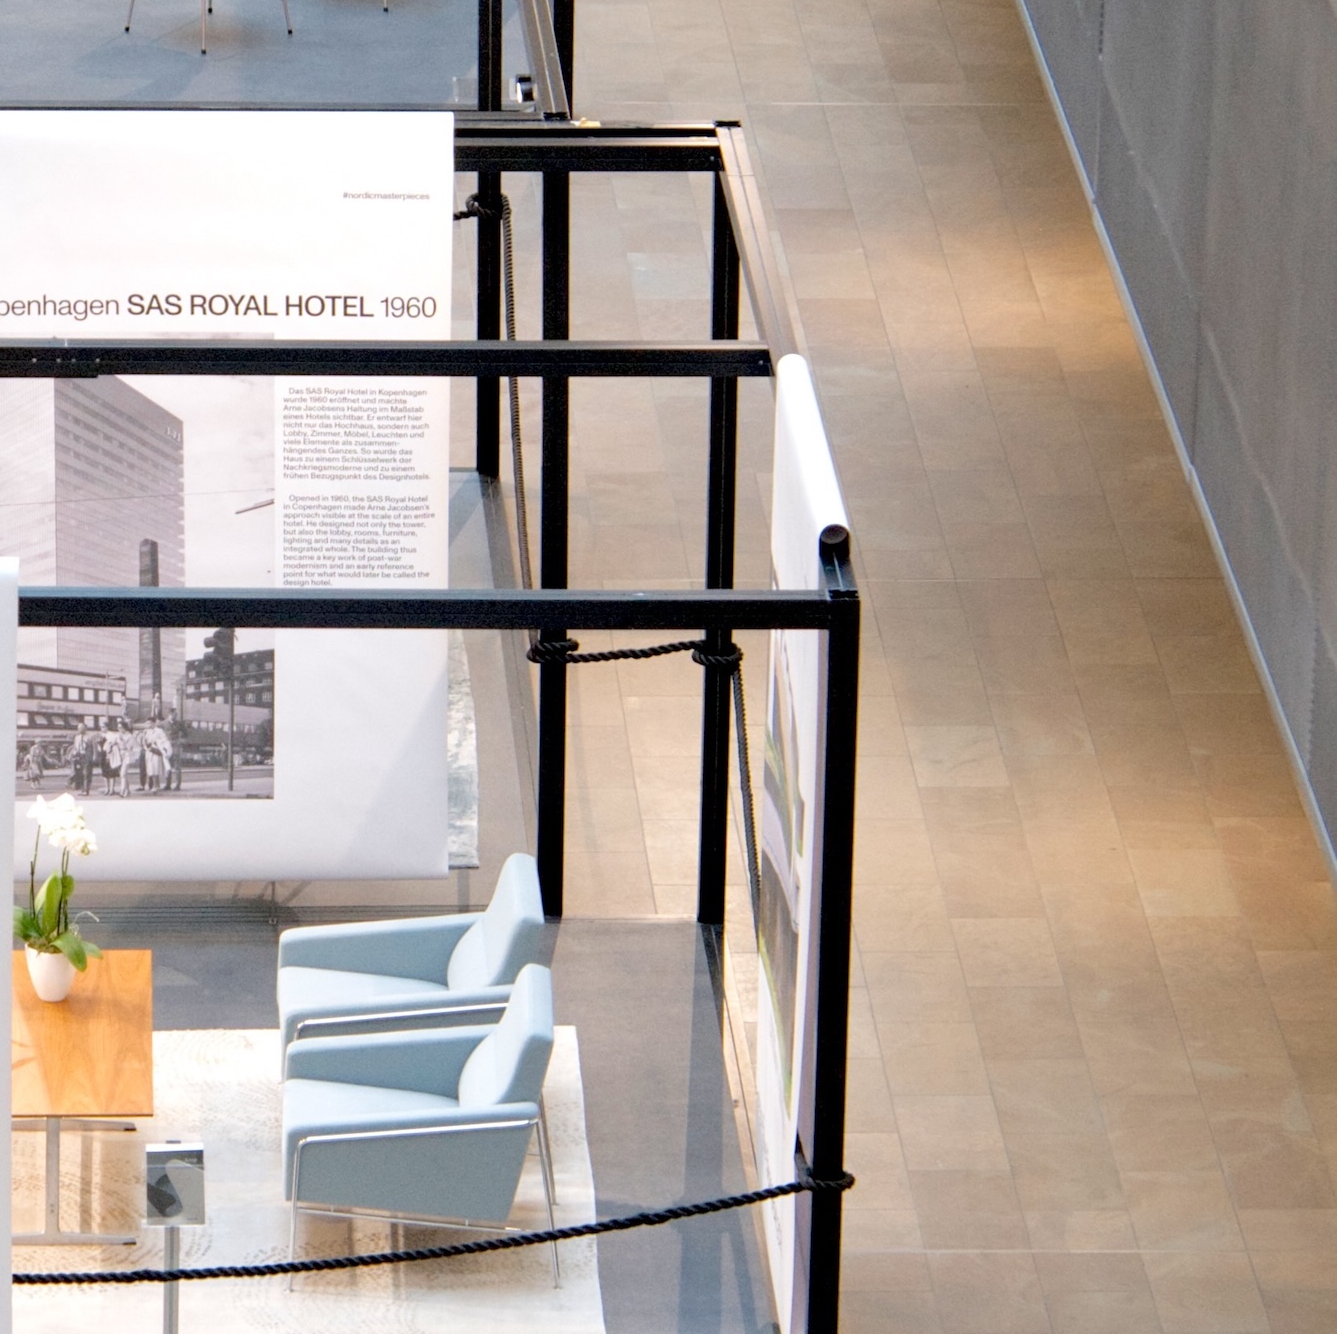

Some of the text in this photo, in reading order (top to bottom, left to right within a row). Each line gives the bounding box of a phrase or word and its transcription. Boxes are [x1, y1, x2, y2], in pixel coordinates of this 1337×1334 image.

[343, 192, 430, 201] #nordicmasterpieces
[127, 294, 182, 316] SAS
[191, 295, 278, 316] ROYAL
[285, 295, 374, 317] HOTEL
[380, 297, 437, 318] 1960
[324, 388, 345, 396] Royal
[379, 389, 427, 397] Kopenhagen
[289, 495, 320, 503] Opened
